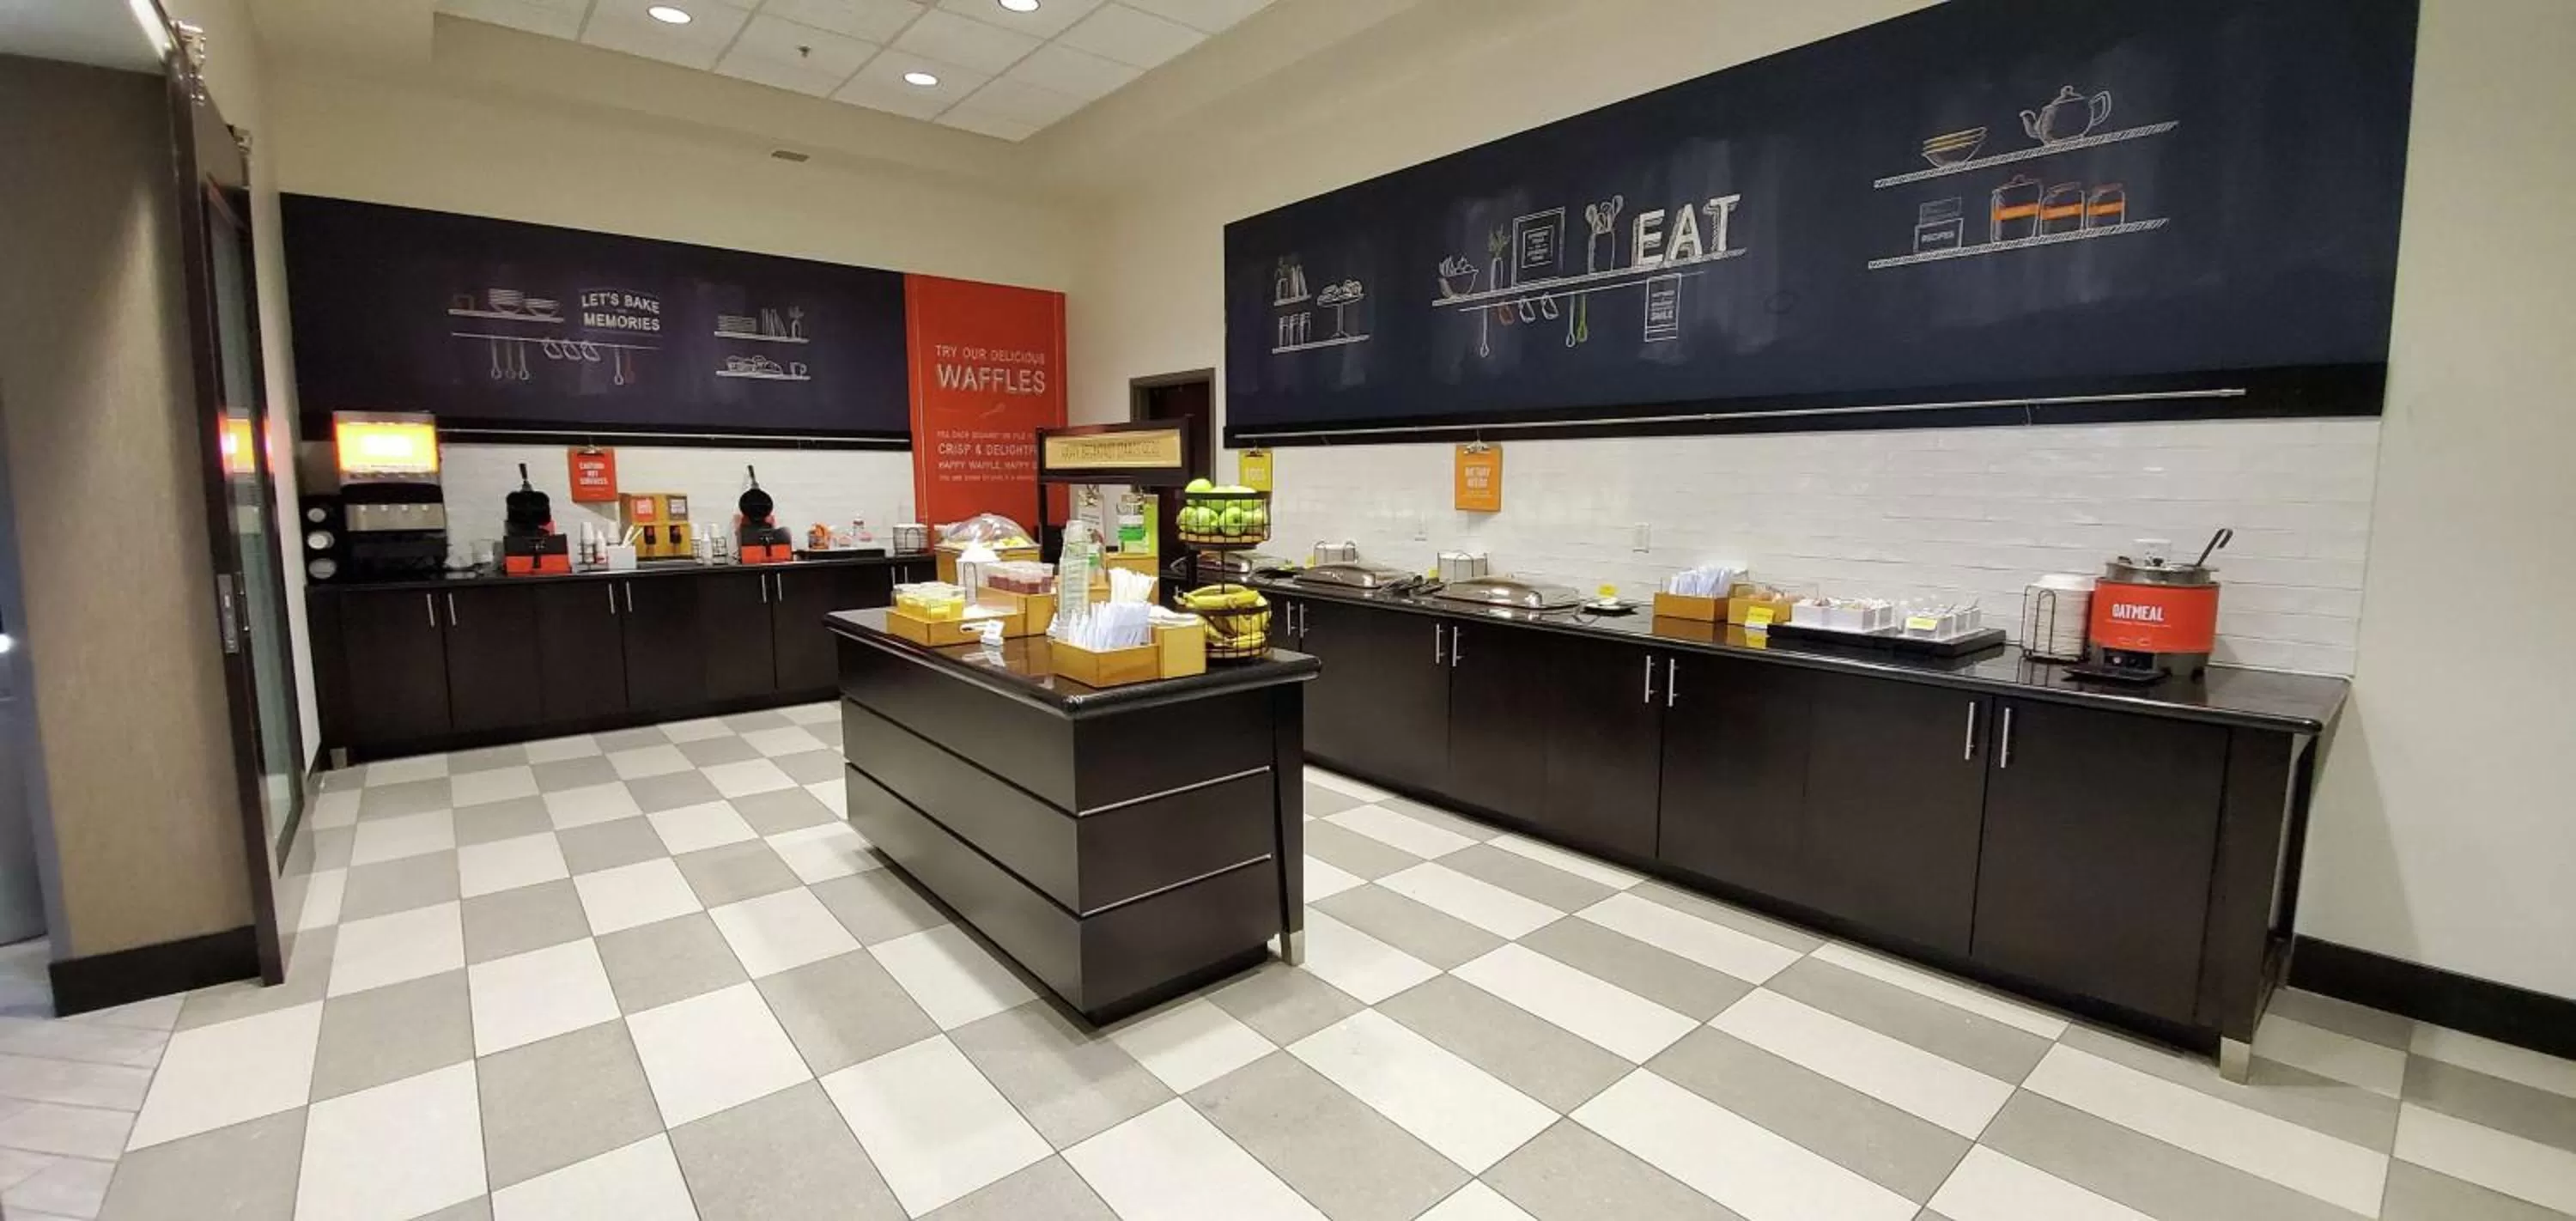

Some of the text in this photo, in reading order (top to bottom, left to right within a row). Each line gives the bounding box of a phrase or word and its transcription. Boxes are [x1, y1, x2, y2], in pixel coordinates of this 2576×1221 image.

[1632, 193, 1741, 269] EAT
[581, 292, 660, 314] LET'S BAKE
[584, 313, 660, 331] MEMORIES
[935, 344, 1045, 366] TRY OUR DELICIOUS
[936, 363, 1046, 397] WAFFLES
[938, 442, 972, 456] CRISP
[986, 444, 1036, 457] DELIGHTF
[2111, 604, 2165, 622] OATMEAL
